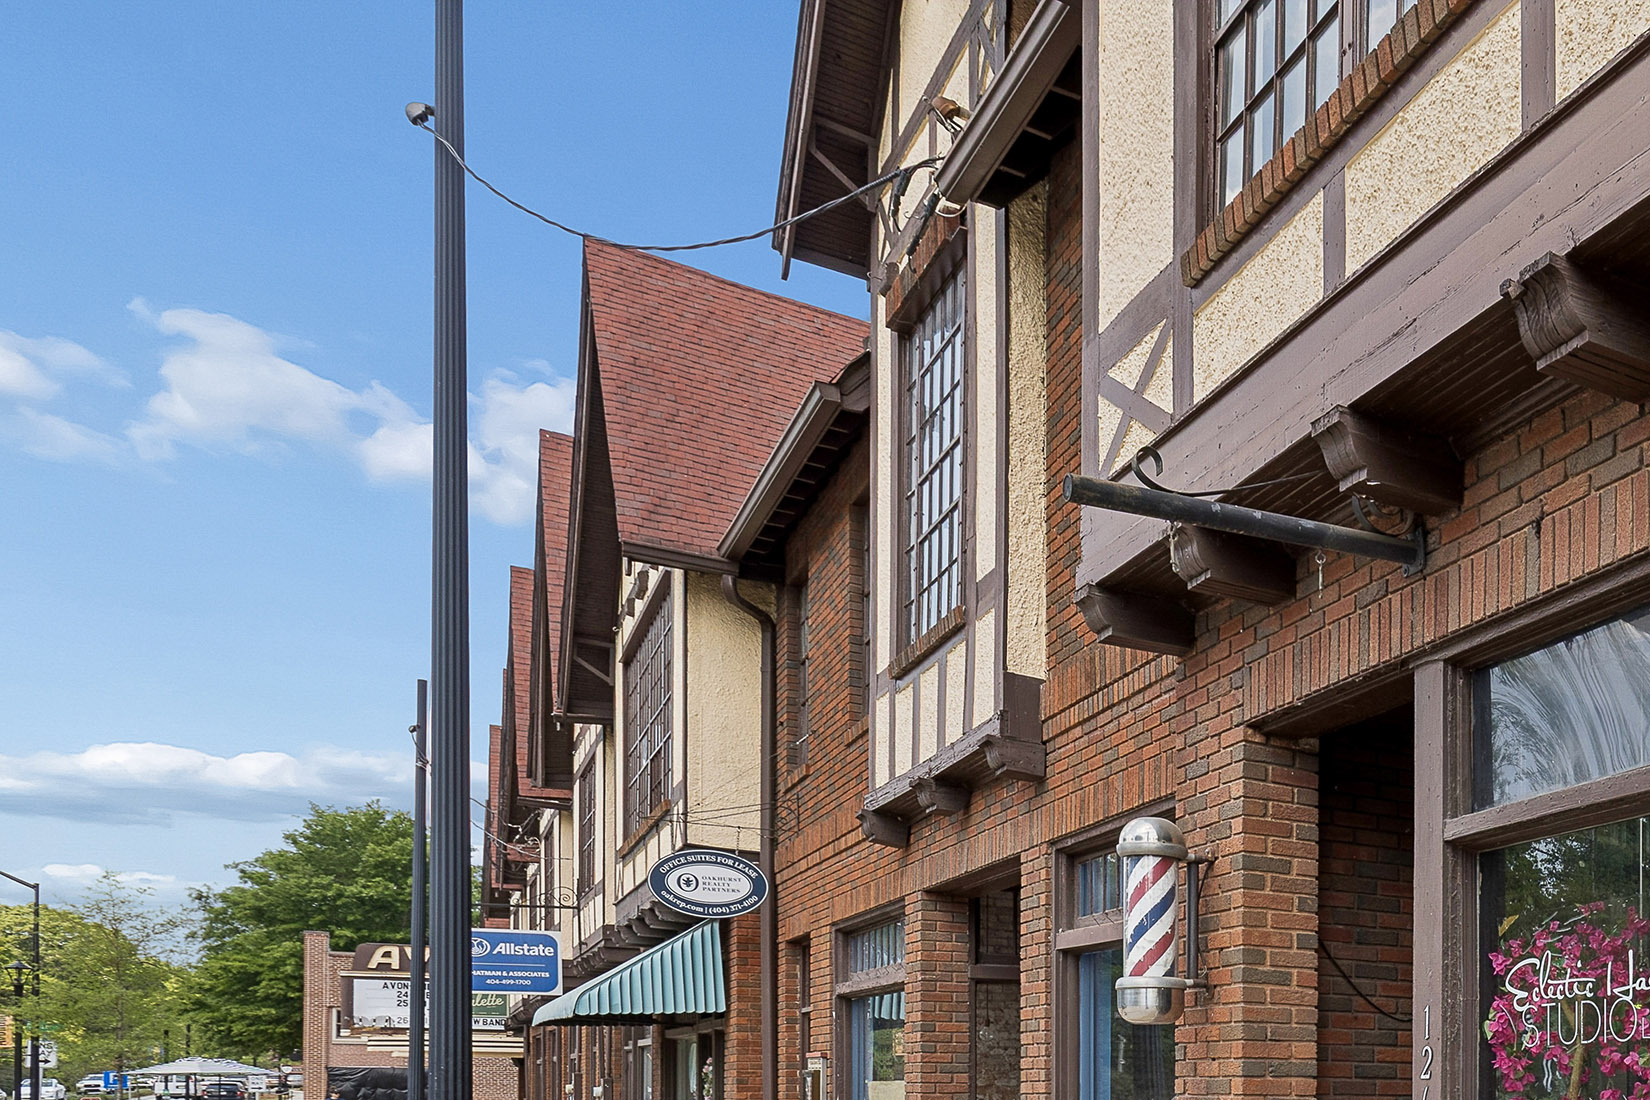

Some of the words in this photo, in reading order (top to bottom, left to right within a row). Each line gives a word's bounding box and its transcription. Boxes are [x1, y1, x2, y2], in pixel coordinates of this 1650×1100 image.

[659, 857, 687, 874] OFFICE
[688, 854, 717, 862] SUITES
[717, 856, 734, 866] FOR
[734, 862, 759, 879] LEASE
[708, 906, 730, 914] (404)
[492, 942, 555, 957] Allstate
[485, 978, 532, 986] 404-499-1700
[1505, 949, 1597, 1012] Eclectic
[396, 991, 409, 999] 24
[1521, 996, 1638, 1048] STUDIO
